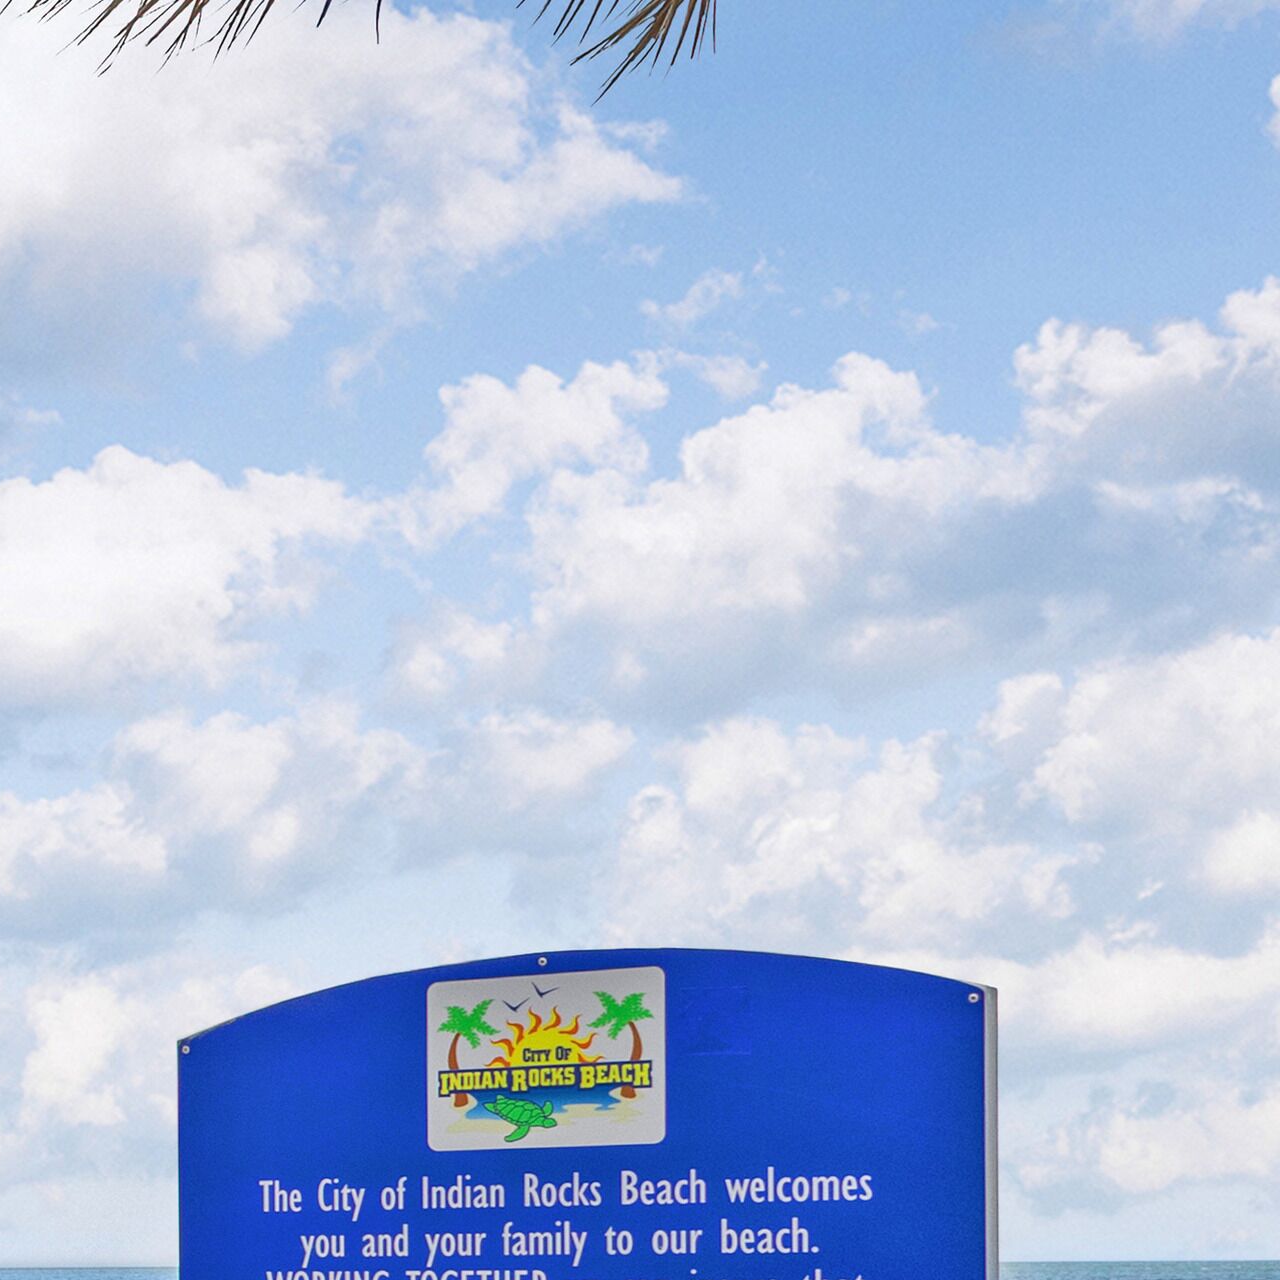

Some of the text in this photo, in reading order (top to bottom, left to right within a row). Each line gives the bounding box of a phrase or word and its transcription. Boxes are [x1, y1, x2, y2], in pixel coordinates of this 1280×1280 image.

[440, 1063, 650, 1094] INDIAN ROCKS BEACH
[258, 1166, 873, 1222] The City of Indian Rocks Beach welcomes
[300, 1217, 819, 1269] you and your family to our beach.
